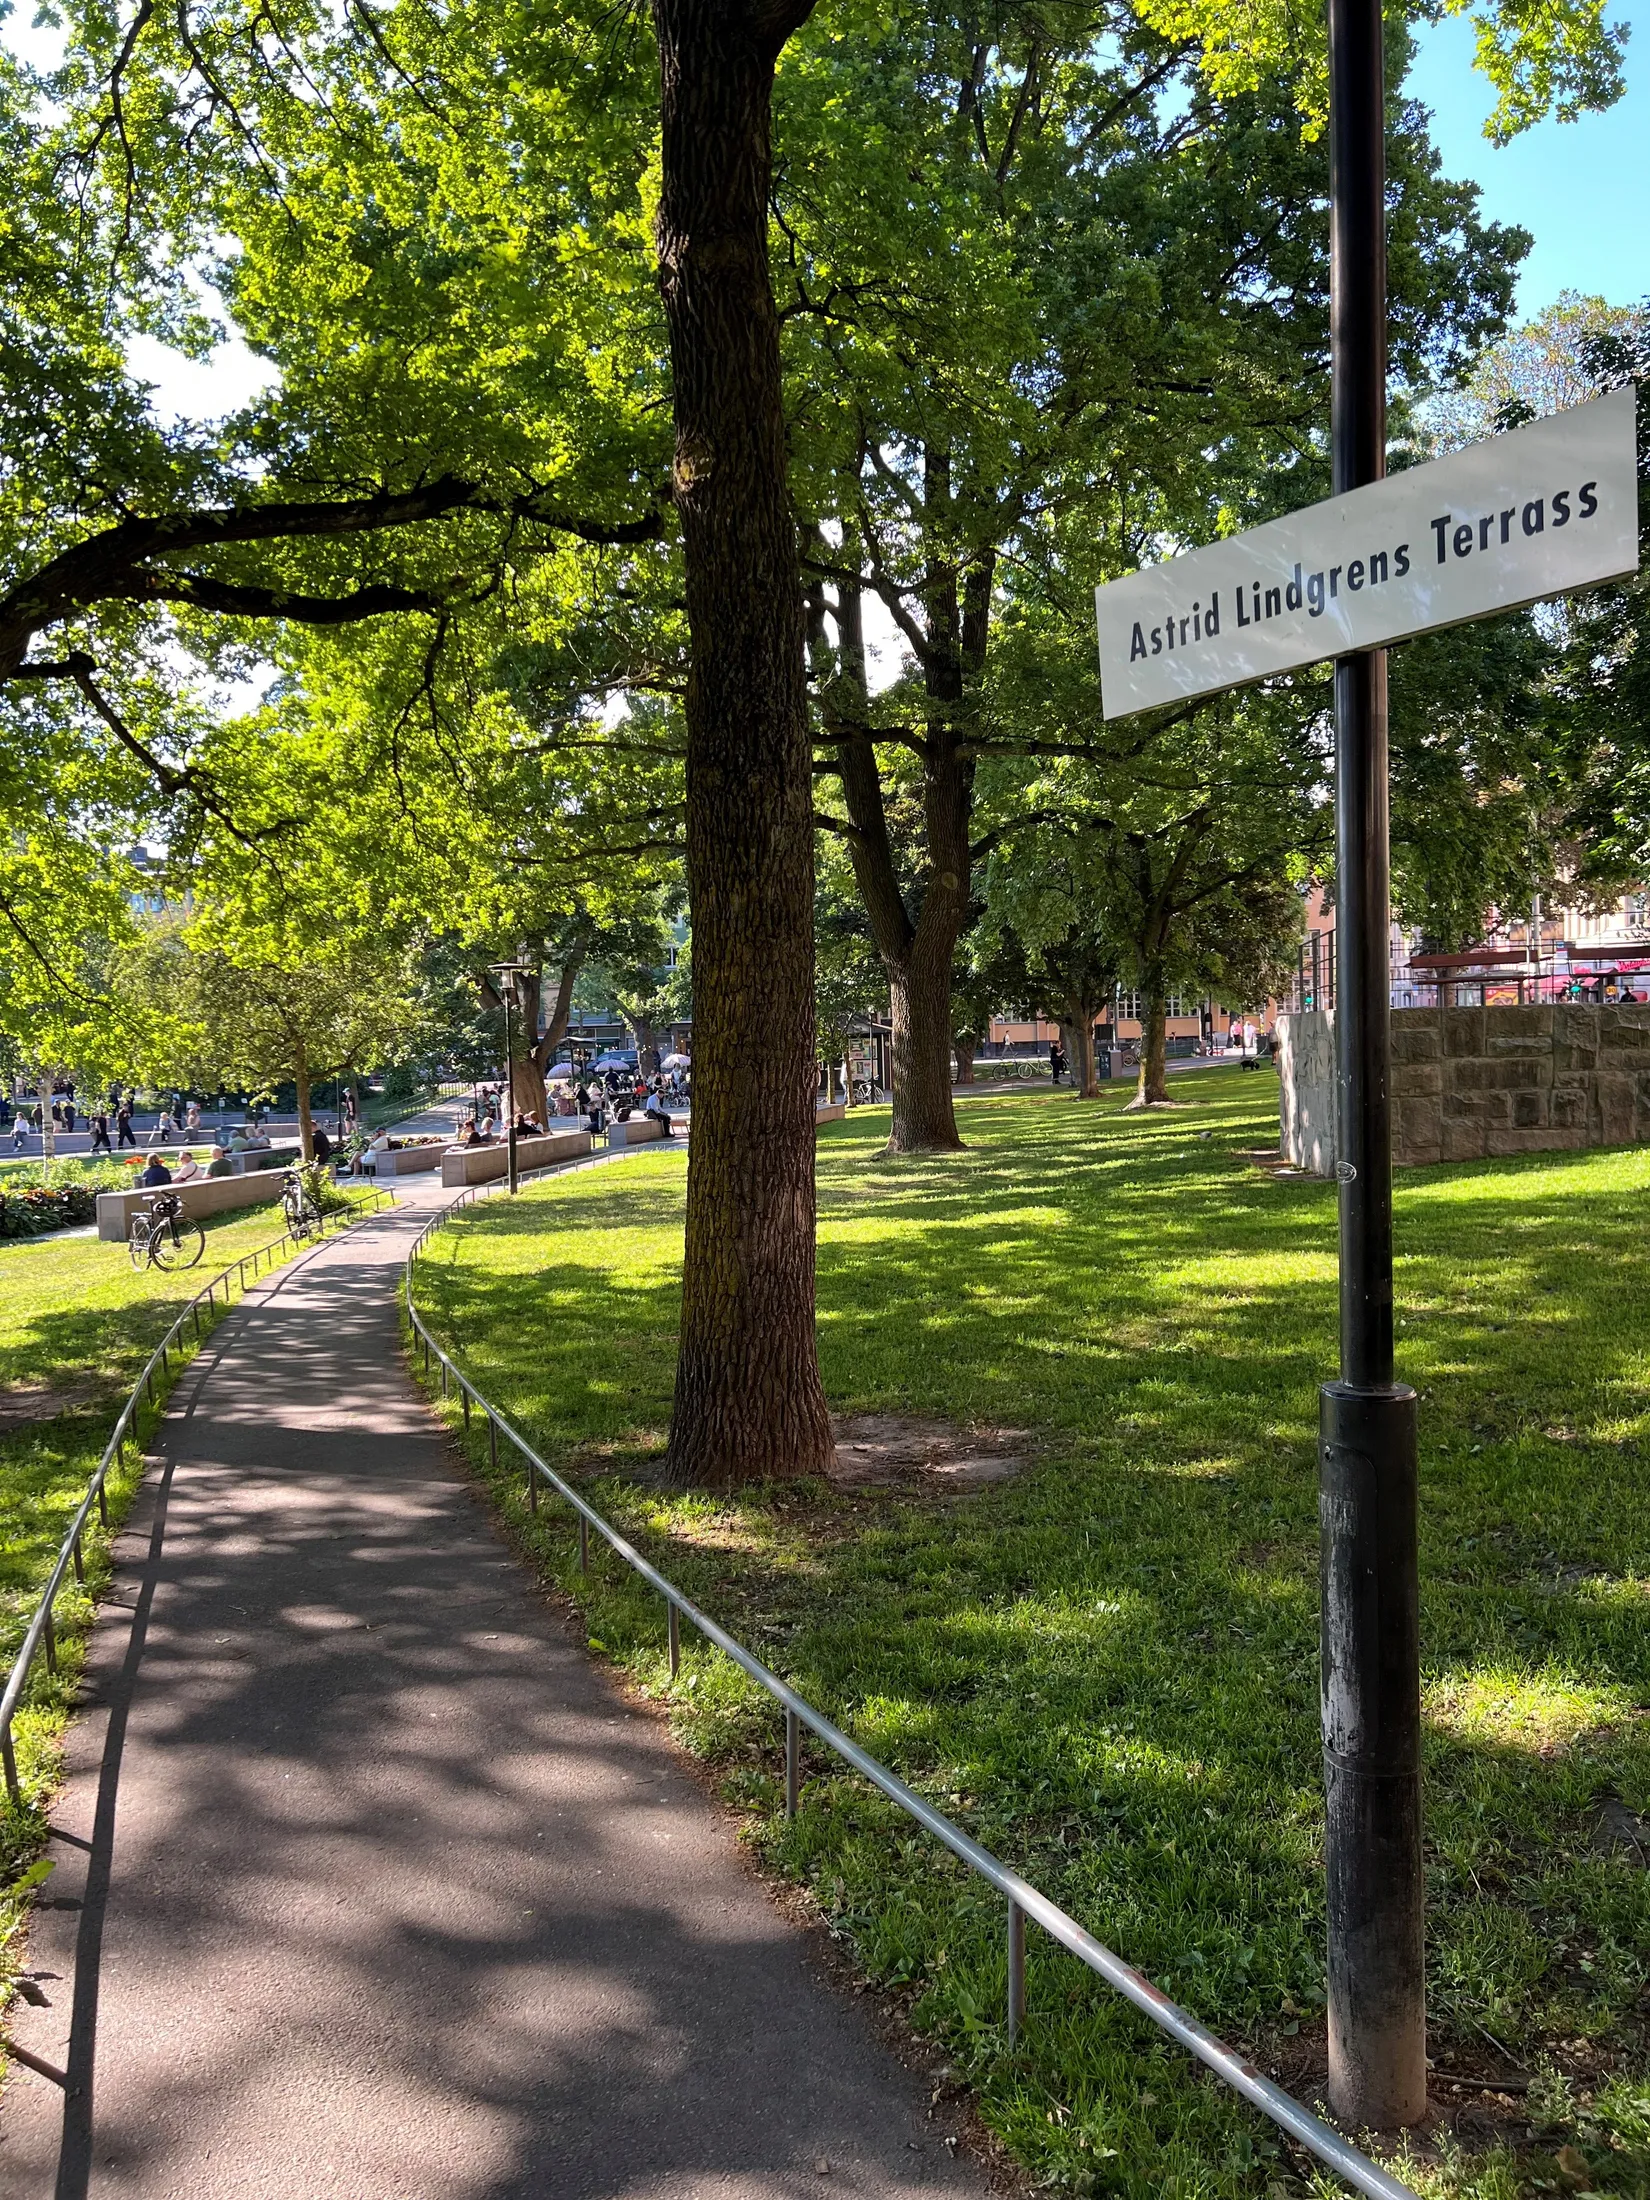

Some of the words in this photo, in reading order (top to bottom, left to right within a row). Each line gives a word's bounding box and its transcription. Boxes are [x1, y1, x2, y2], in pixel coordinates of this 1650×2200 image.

[1129, 591, 1220, 663] Astrid
[1235, 543, 1411, 628] Lindgrens
[1430, 481, 1598, 565] Terrass
